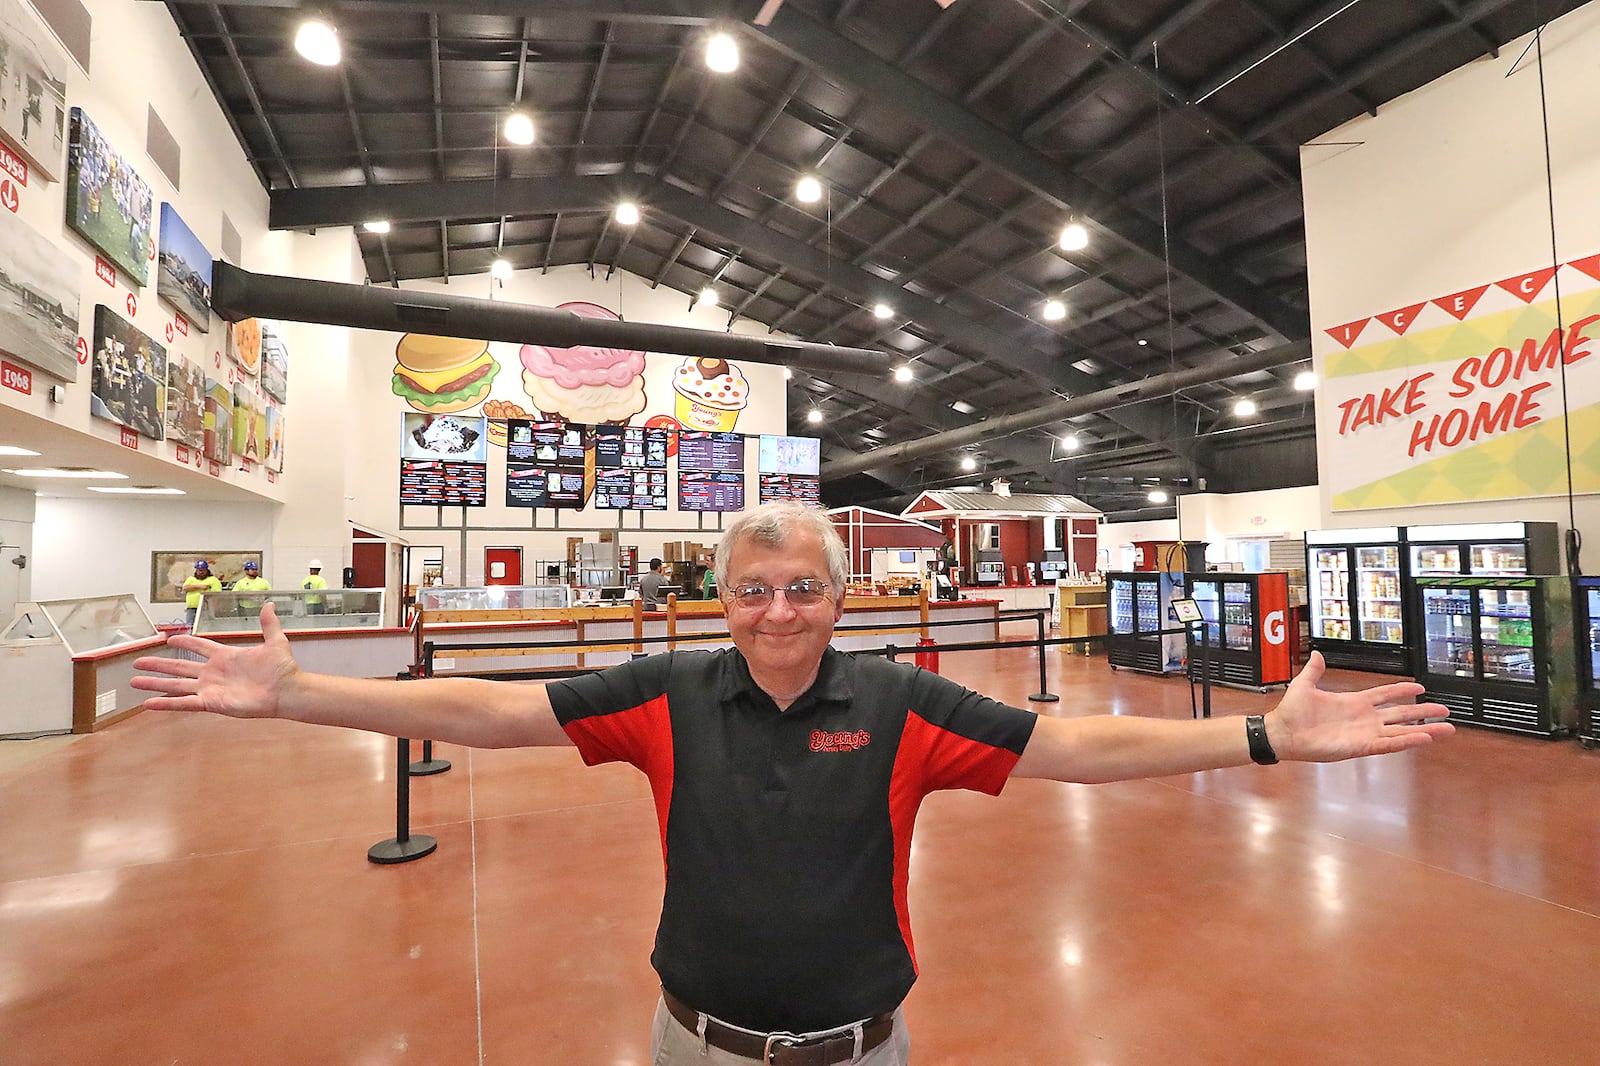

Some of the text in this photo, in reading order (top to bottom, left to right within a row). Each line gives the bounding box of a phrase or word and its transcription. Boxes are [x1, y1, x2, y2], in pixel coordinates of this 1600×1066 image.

[0, 150, 25, 180] 1958
[4, 369, 29, 390] 1968
[1338, 313, 1600, 436] TAKE SOME
[692, 402, 722, 418] Young's
[1408, 381, 1552, 457] HOME
[1263, 610, 1285, 645] G
[809, 729, 871, 752] Young's
